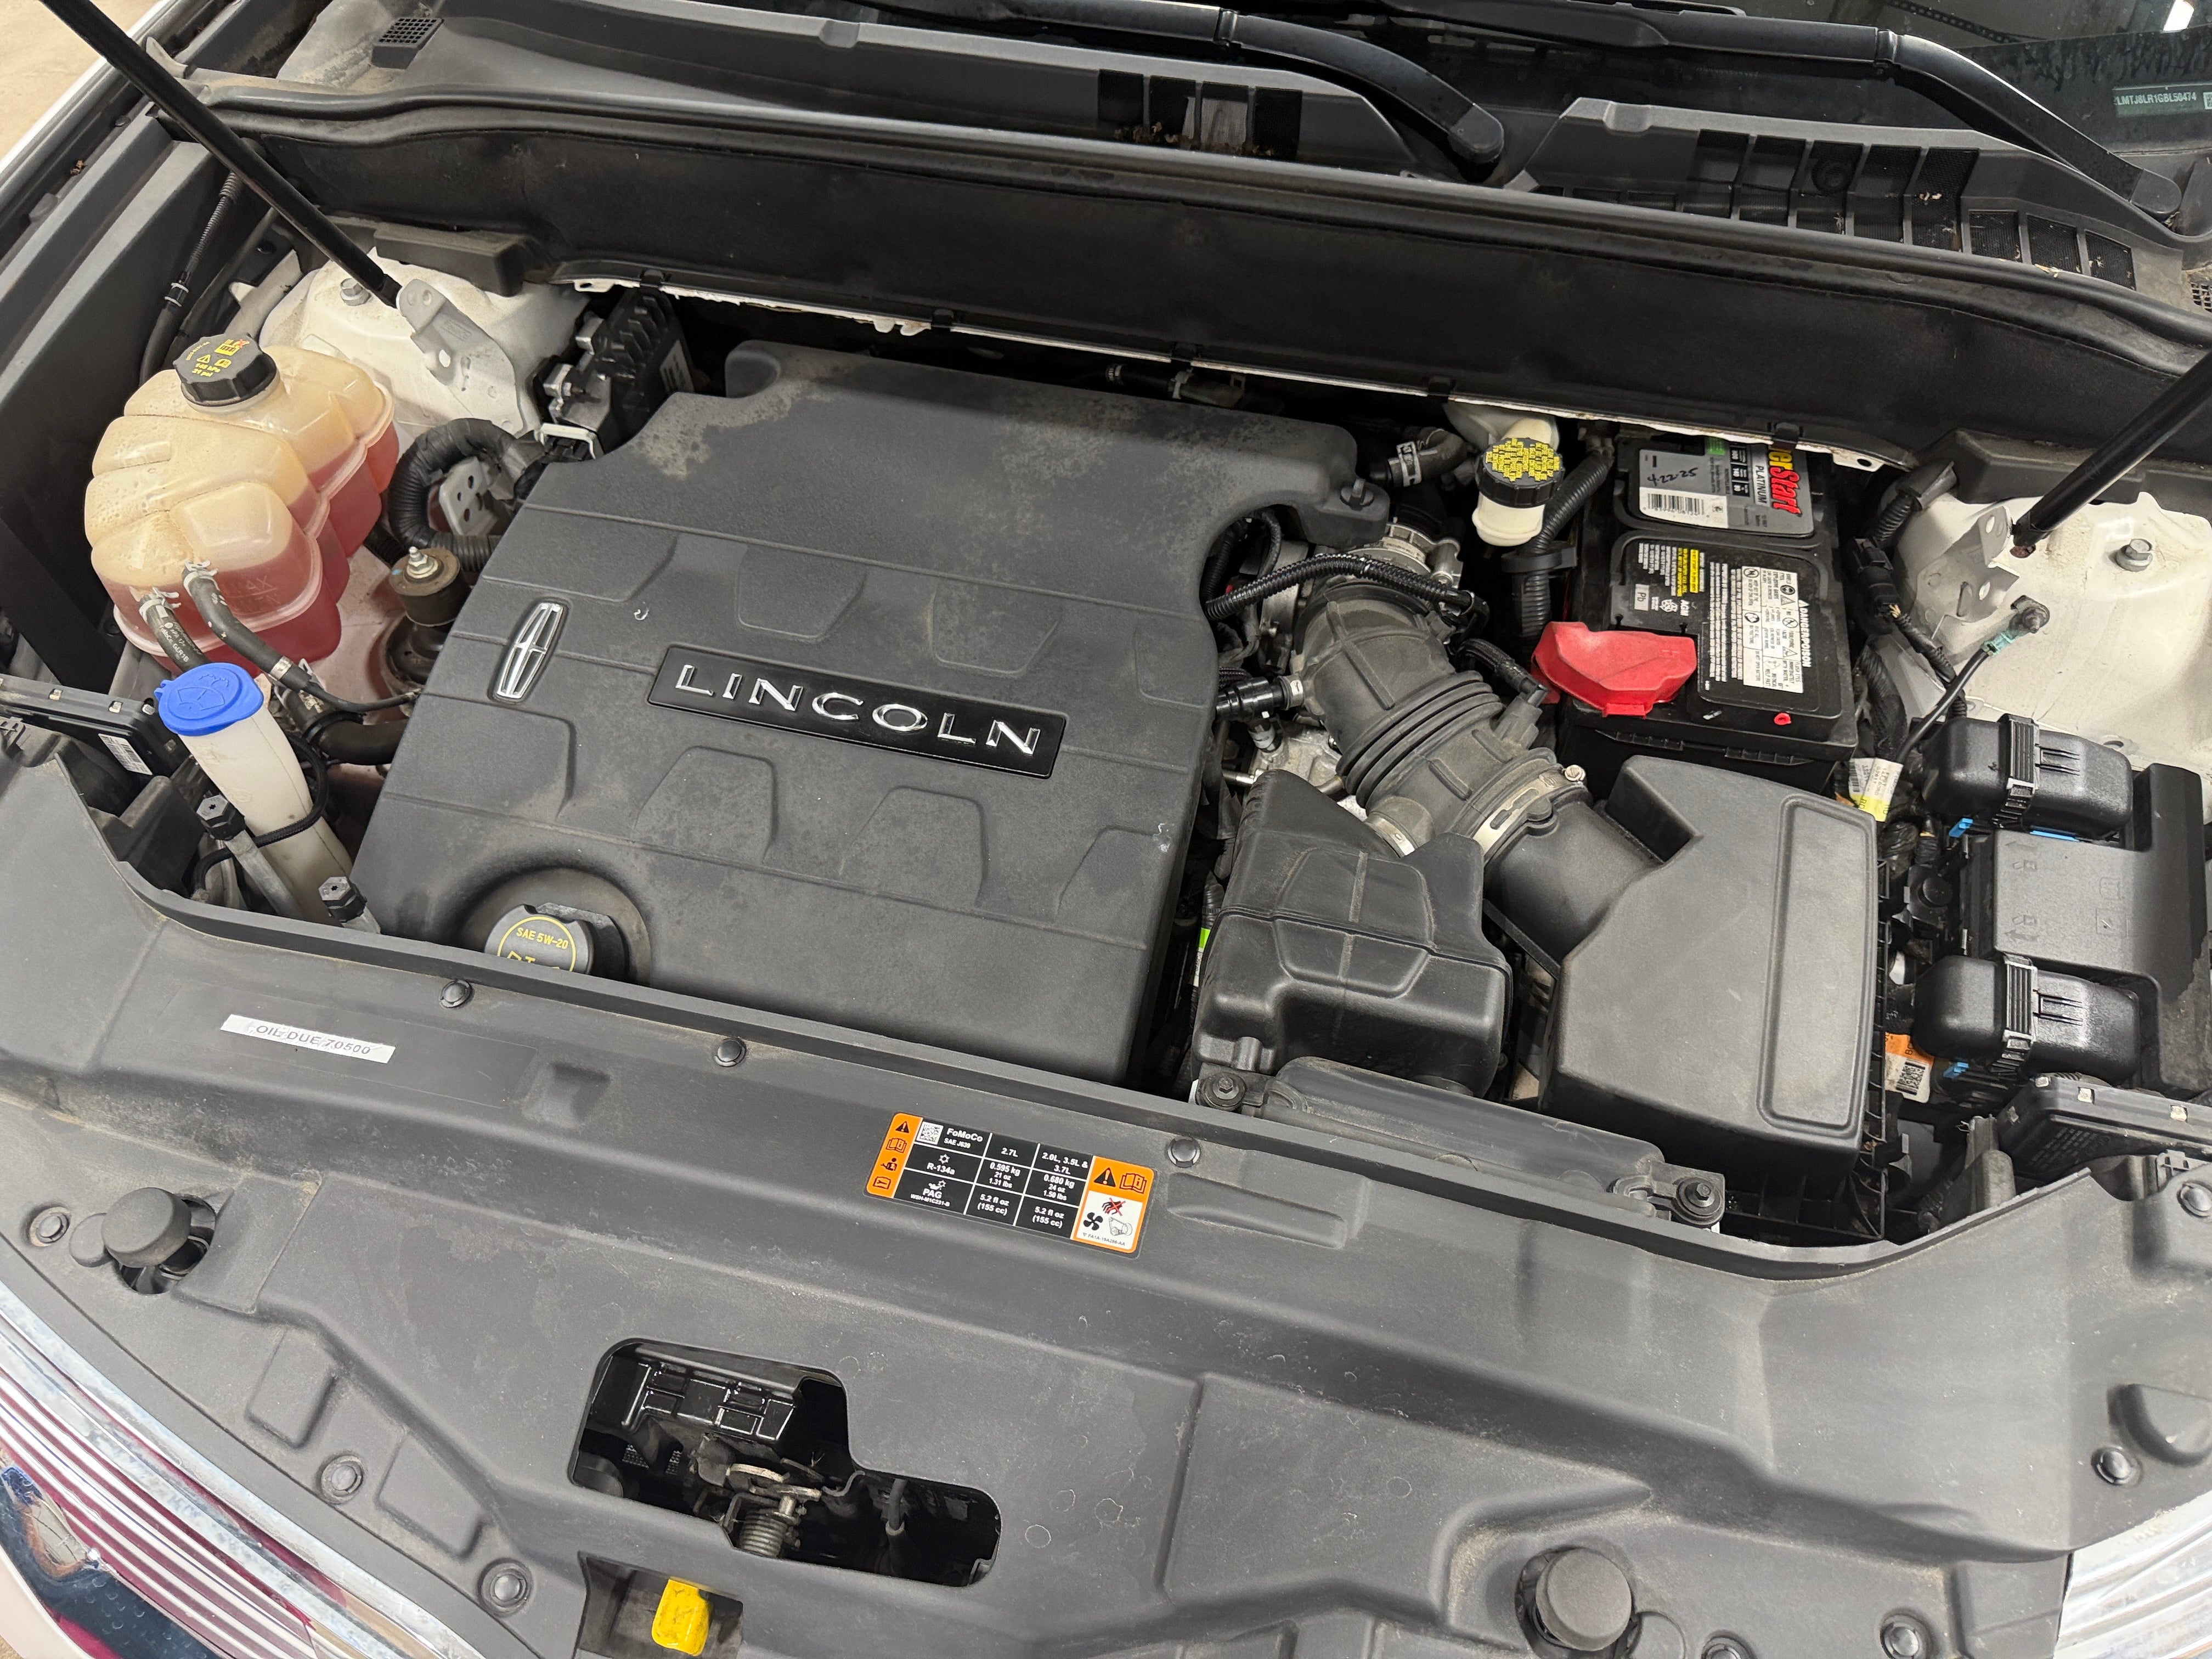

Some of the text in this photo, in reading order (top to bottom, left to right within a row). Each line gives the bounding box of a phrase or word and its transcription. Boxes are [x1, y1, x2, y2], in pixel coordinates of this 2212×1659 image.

[1755, 465, 1768, 504] PLATINUM
[1768, 449, 1802, 514] erStart
[1637, 592, 1646, 602] Pb
[1680, 599, 1690, 617] AGM
[675, 664, 1041, 756] LINCOLN
[516, 927, 569, 949] SAE 5W-20
[256, 1025, 371, 1054] OIL DUE 70500
[946, 1128, 983, 1142] FoMoCo
[944, 1137, 971, 1149] SAE J639
[1001, 1147, 1019, 1158] 2.7L
[1042, 1152, 1061, 1164] 2.0L,
[1063, 1156, 1080, 1167] 3.5L
[927, 1163, 955, 1175] R-134a
[990, 1162, 1021, 1177] 0.595 kg
[1053, 1164, 1071, 1175] 3.7L
[989, 1177, 1002, 1186] 1.31
[1043, 1174, 1075, 1189] 0.680 kg
[922, 1188, 943, 1199] PAG
[979, 1194, 992, 1203] 5.2
[1043, 1190, 1067, 1201] 1.50 lbs
[977, 1202, 1008, 1216] (155 cc)
[1034, 1206, 1047, 1215] 5.2
[1047, 1209, 1054, 1217] fl
[1032, 1215, 1063, 1229] (155 cc)
